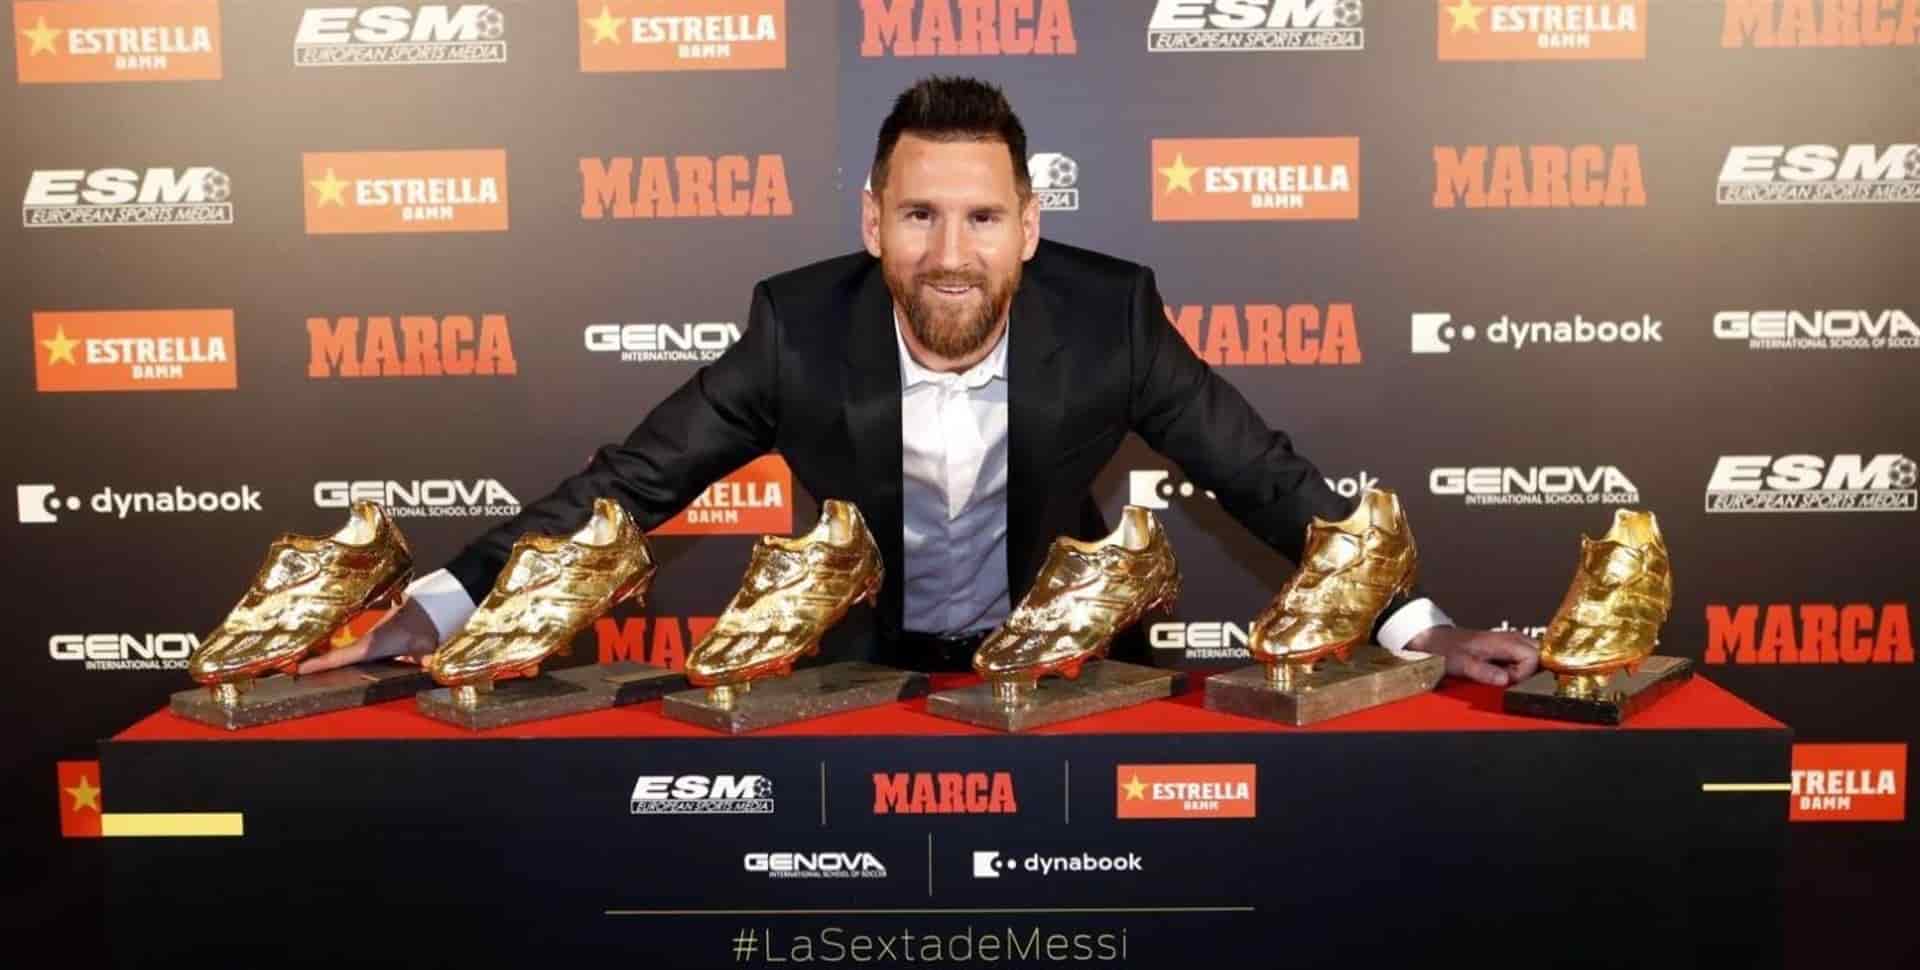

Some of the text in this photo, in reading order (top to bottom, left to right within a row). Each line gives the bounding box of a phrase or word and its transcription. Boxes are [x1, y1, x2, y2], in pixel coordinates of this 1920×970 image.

[295, 6, 492, 43] ESM
[860, 0, 1077, 56] MARCA
[1149, 0, 1344, 29] ESM
[1491, 4, 1637, 32] ESTRELLA
[69, 26, 211, 54] ESTRELLA
[631, 15, 776, 43] ESTRELLA
[1157, 31, 1355, 48] EUROPEAN SPORTS MEDIA
[1538, 33, 1590, 48] DAMM
[115, 55, 167, 70] DAMM
[303, 45, 499, 62] EUROPEAN SPORTS MEDIA
[678, 44, 731, 58] DAMM
[1432, 144, 1647, 208] MARCA
[1719, 145, 1913, 182] ESM
[23, 168, 215, 204] ESM
[356, 177, 497, 205] ESTRELLA
[580, 155, 792, 218] MARCA
[1205, 164, 1349, 192] ESTRELLA
[32, 206, 224, 224] EUROPEAN SPORTS MEDIA
[402, 206, 453, 220] DAMM
[1251, 194, 1304, 209] DAMM
[585, 323, 741, 351] GENO
[1487, 315, 1662, 349] dynabook
[1713, 310, 1920, 339] GENOVA
[86, 337, 226, 363] ESTRELLA
[307, 315, 517, 377] MARCA
[1830, 338, 1869, 348] SCHOOL
[1872, 337, 1886, 347] OF
[1888, 337, 1920, 347] SOCCE
[622, 351, 698, 362] INTERNATIONAL
[132, 364, 184, 379] DAMM
[1430, 466, 1638, 495] GENOVA
[1707, 455, 1904, 490] ESM
[91, 485, 262, 518] dynabook
[314, 479, 520, 508] GENOVA
[1465, 494, 1542, 505] INTERNATIONAL
[1545, 494, 1584, 504] SCHOOL
[1586, 494, 1599, 504] OF
[1714, 492, 1908, 509] EUROPEAN SPORTS MEDIA
[429, 506, 467, 516] SCHOOL
[469, 505, 482, 516] OF
[688, 509, 738, 524] DAMM
[49, 633, 200, 660] GENO
[1150, 622, 1256, 649] GEN
[1705, 604, 1914, 664] MARCA
[85, 659, 190, 670] INTERNATIONAL SCHO
[632, 775, 762, 799] ESM
[873, 772, 1017, 814] MARCA
[1152, 783, 1249, 800] ESTRELLA
[1791, 770, 1896, 795] TRELLA
[1799, 796, 1850, 810] DAMM
[744, 853, 887, 871] GENOVA
[1024, 853, 1143, 875] dynabook
[732, 926, 1127, 962] #LaSextadeMessi
